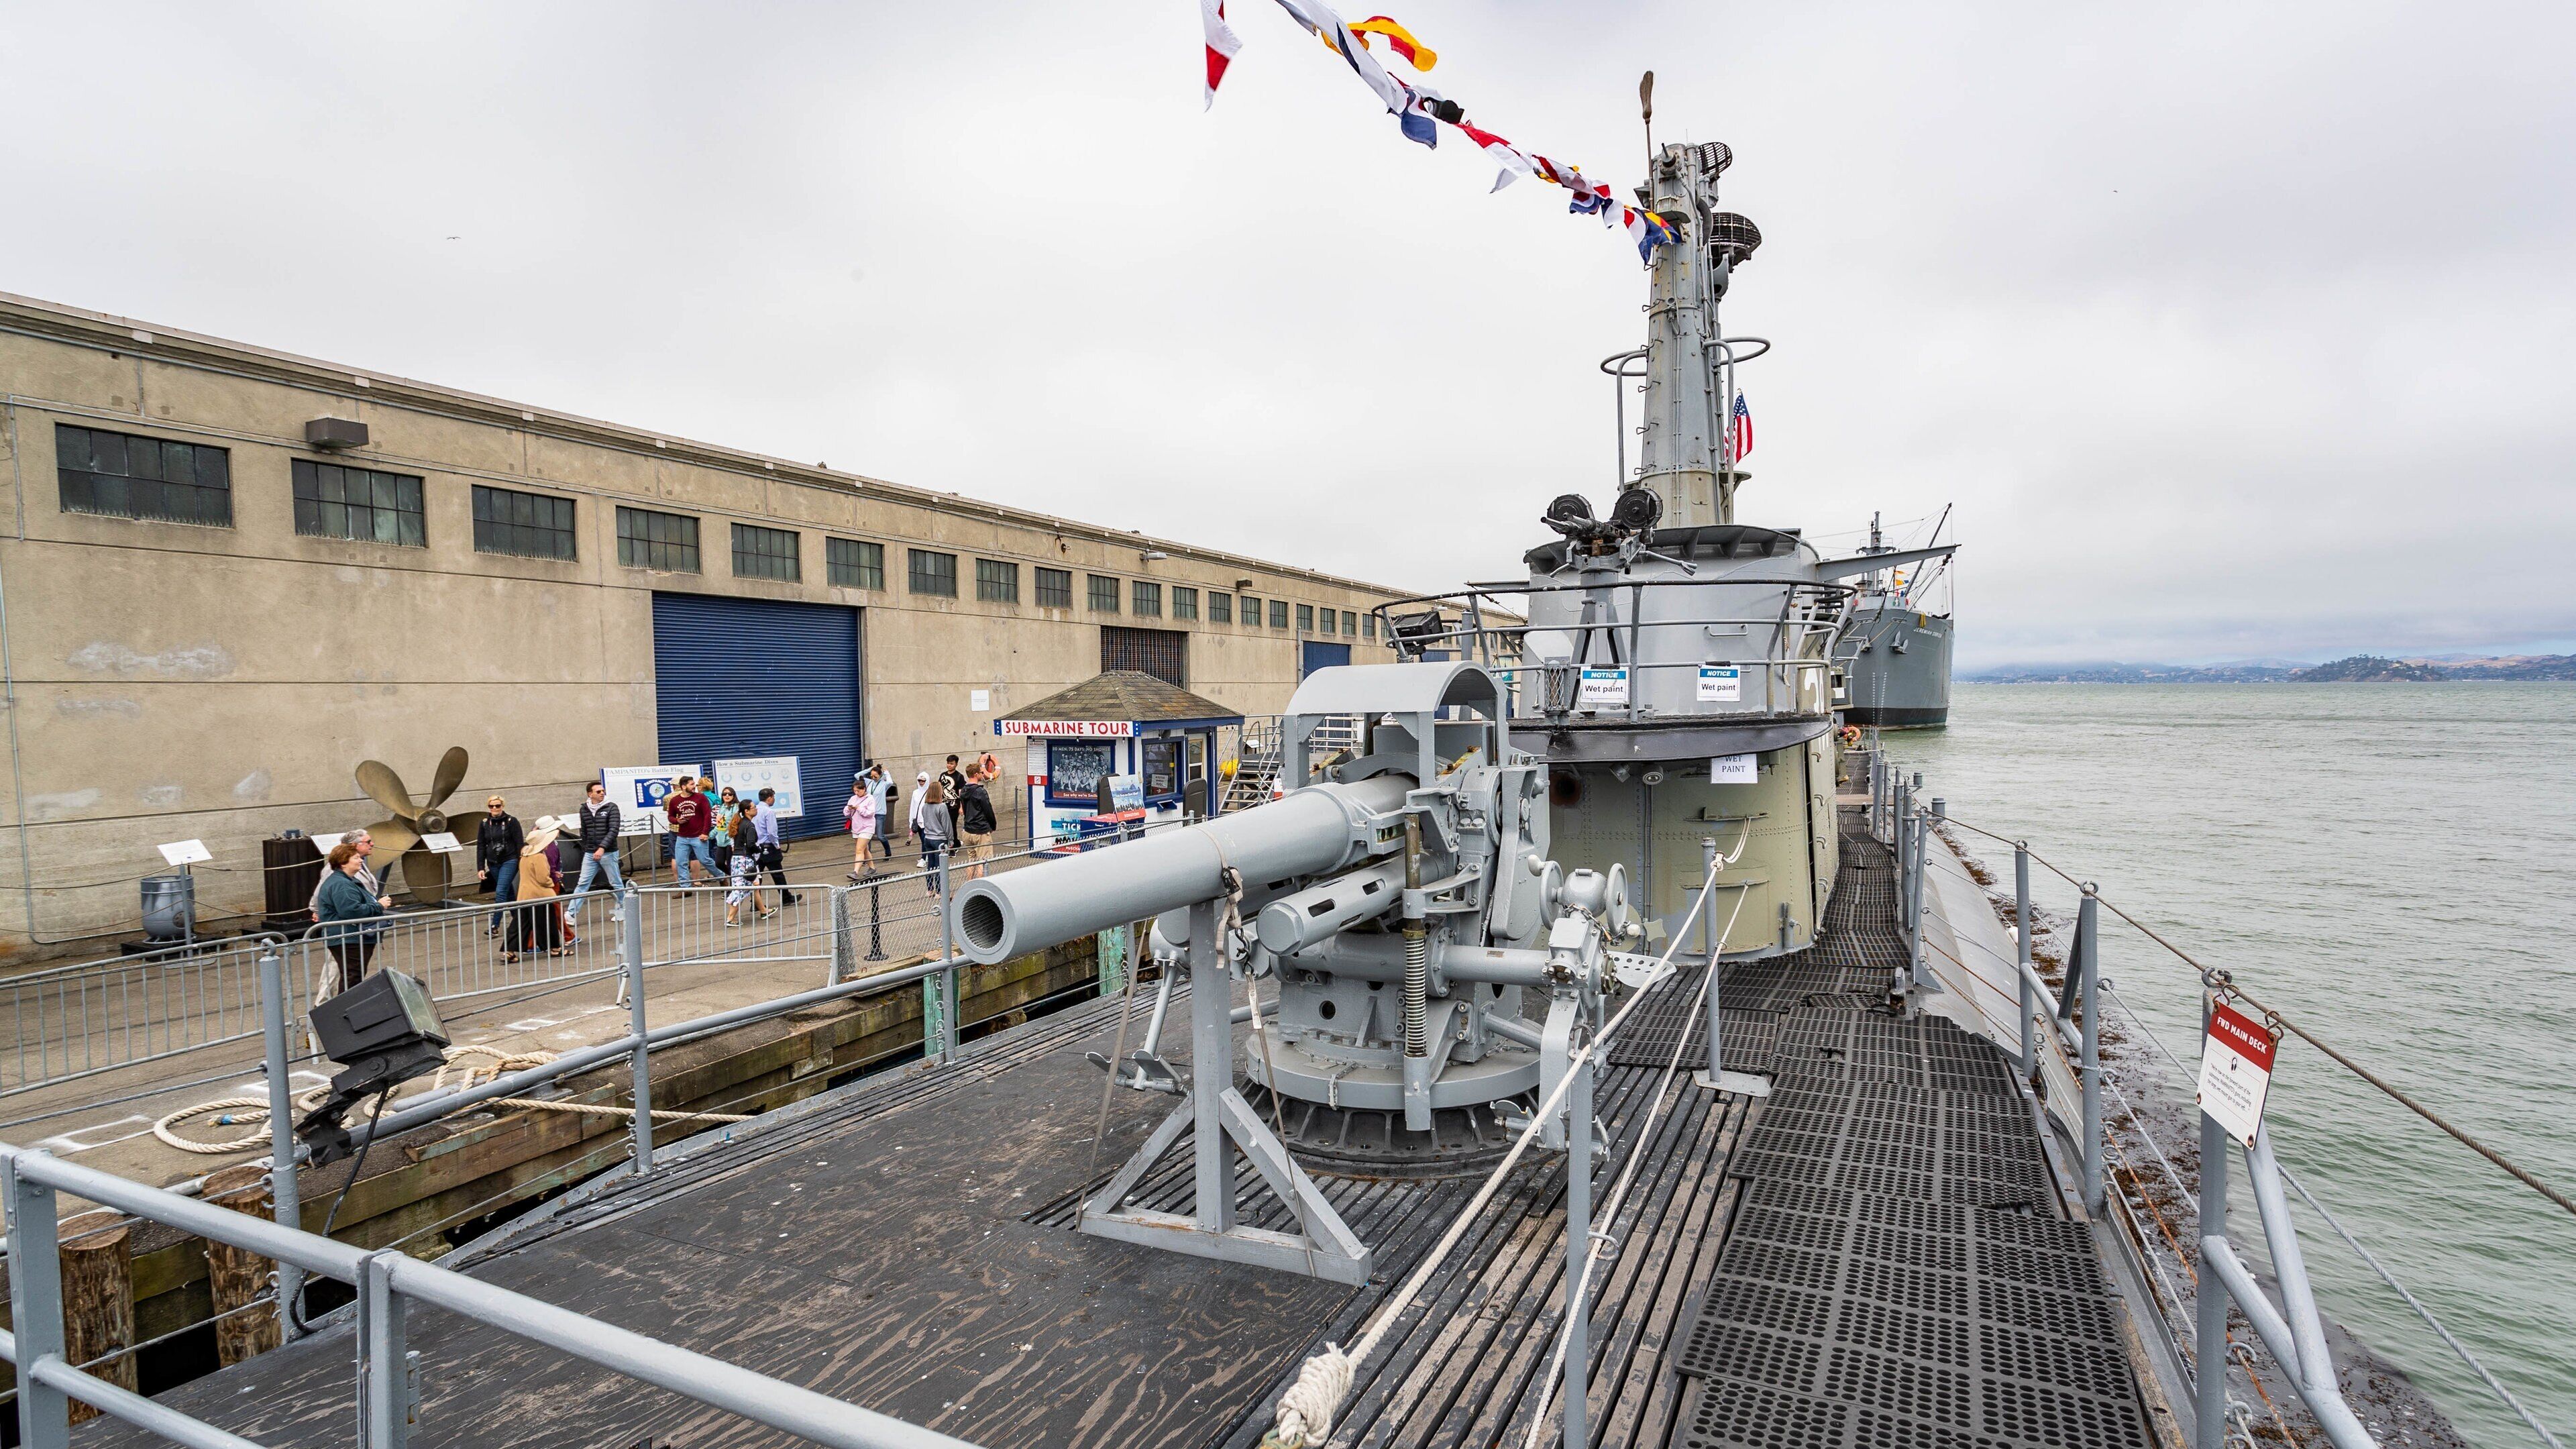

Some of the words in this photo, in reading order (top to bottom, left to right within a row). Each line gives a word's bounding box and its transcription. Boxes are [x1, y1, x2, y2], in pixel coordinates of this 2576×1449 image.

[1603, 685, 1623, 694] paint
[1717, 684, 1735, 692] paint
[1006, 722, 1083, 735] SUBMARINE
[1089, 722, 1130, 735] TOUR
[644, 779, 668, 787] PAMPANITO
[2217, 1016, 2230, 1030] FWD
[2231, 1024, 2249, 1042] MAIN
[2249, 1036, 2267, 1055] DECK
